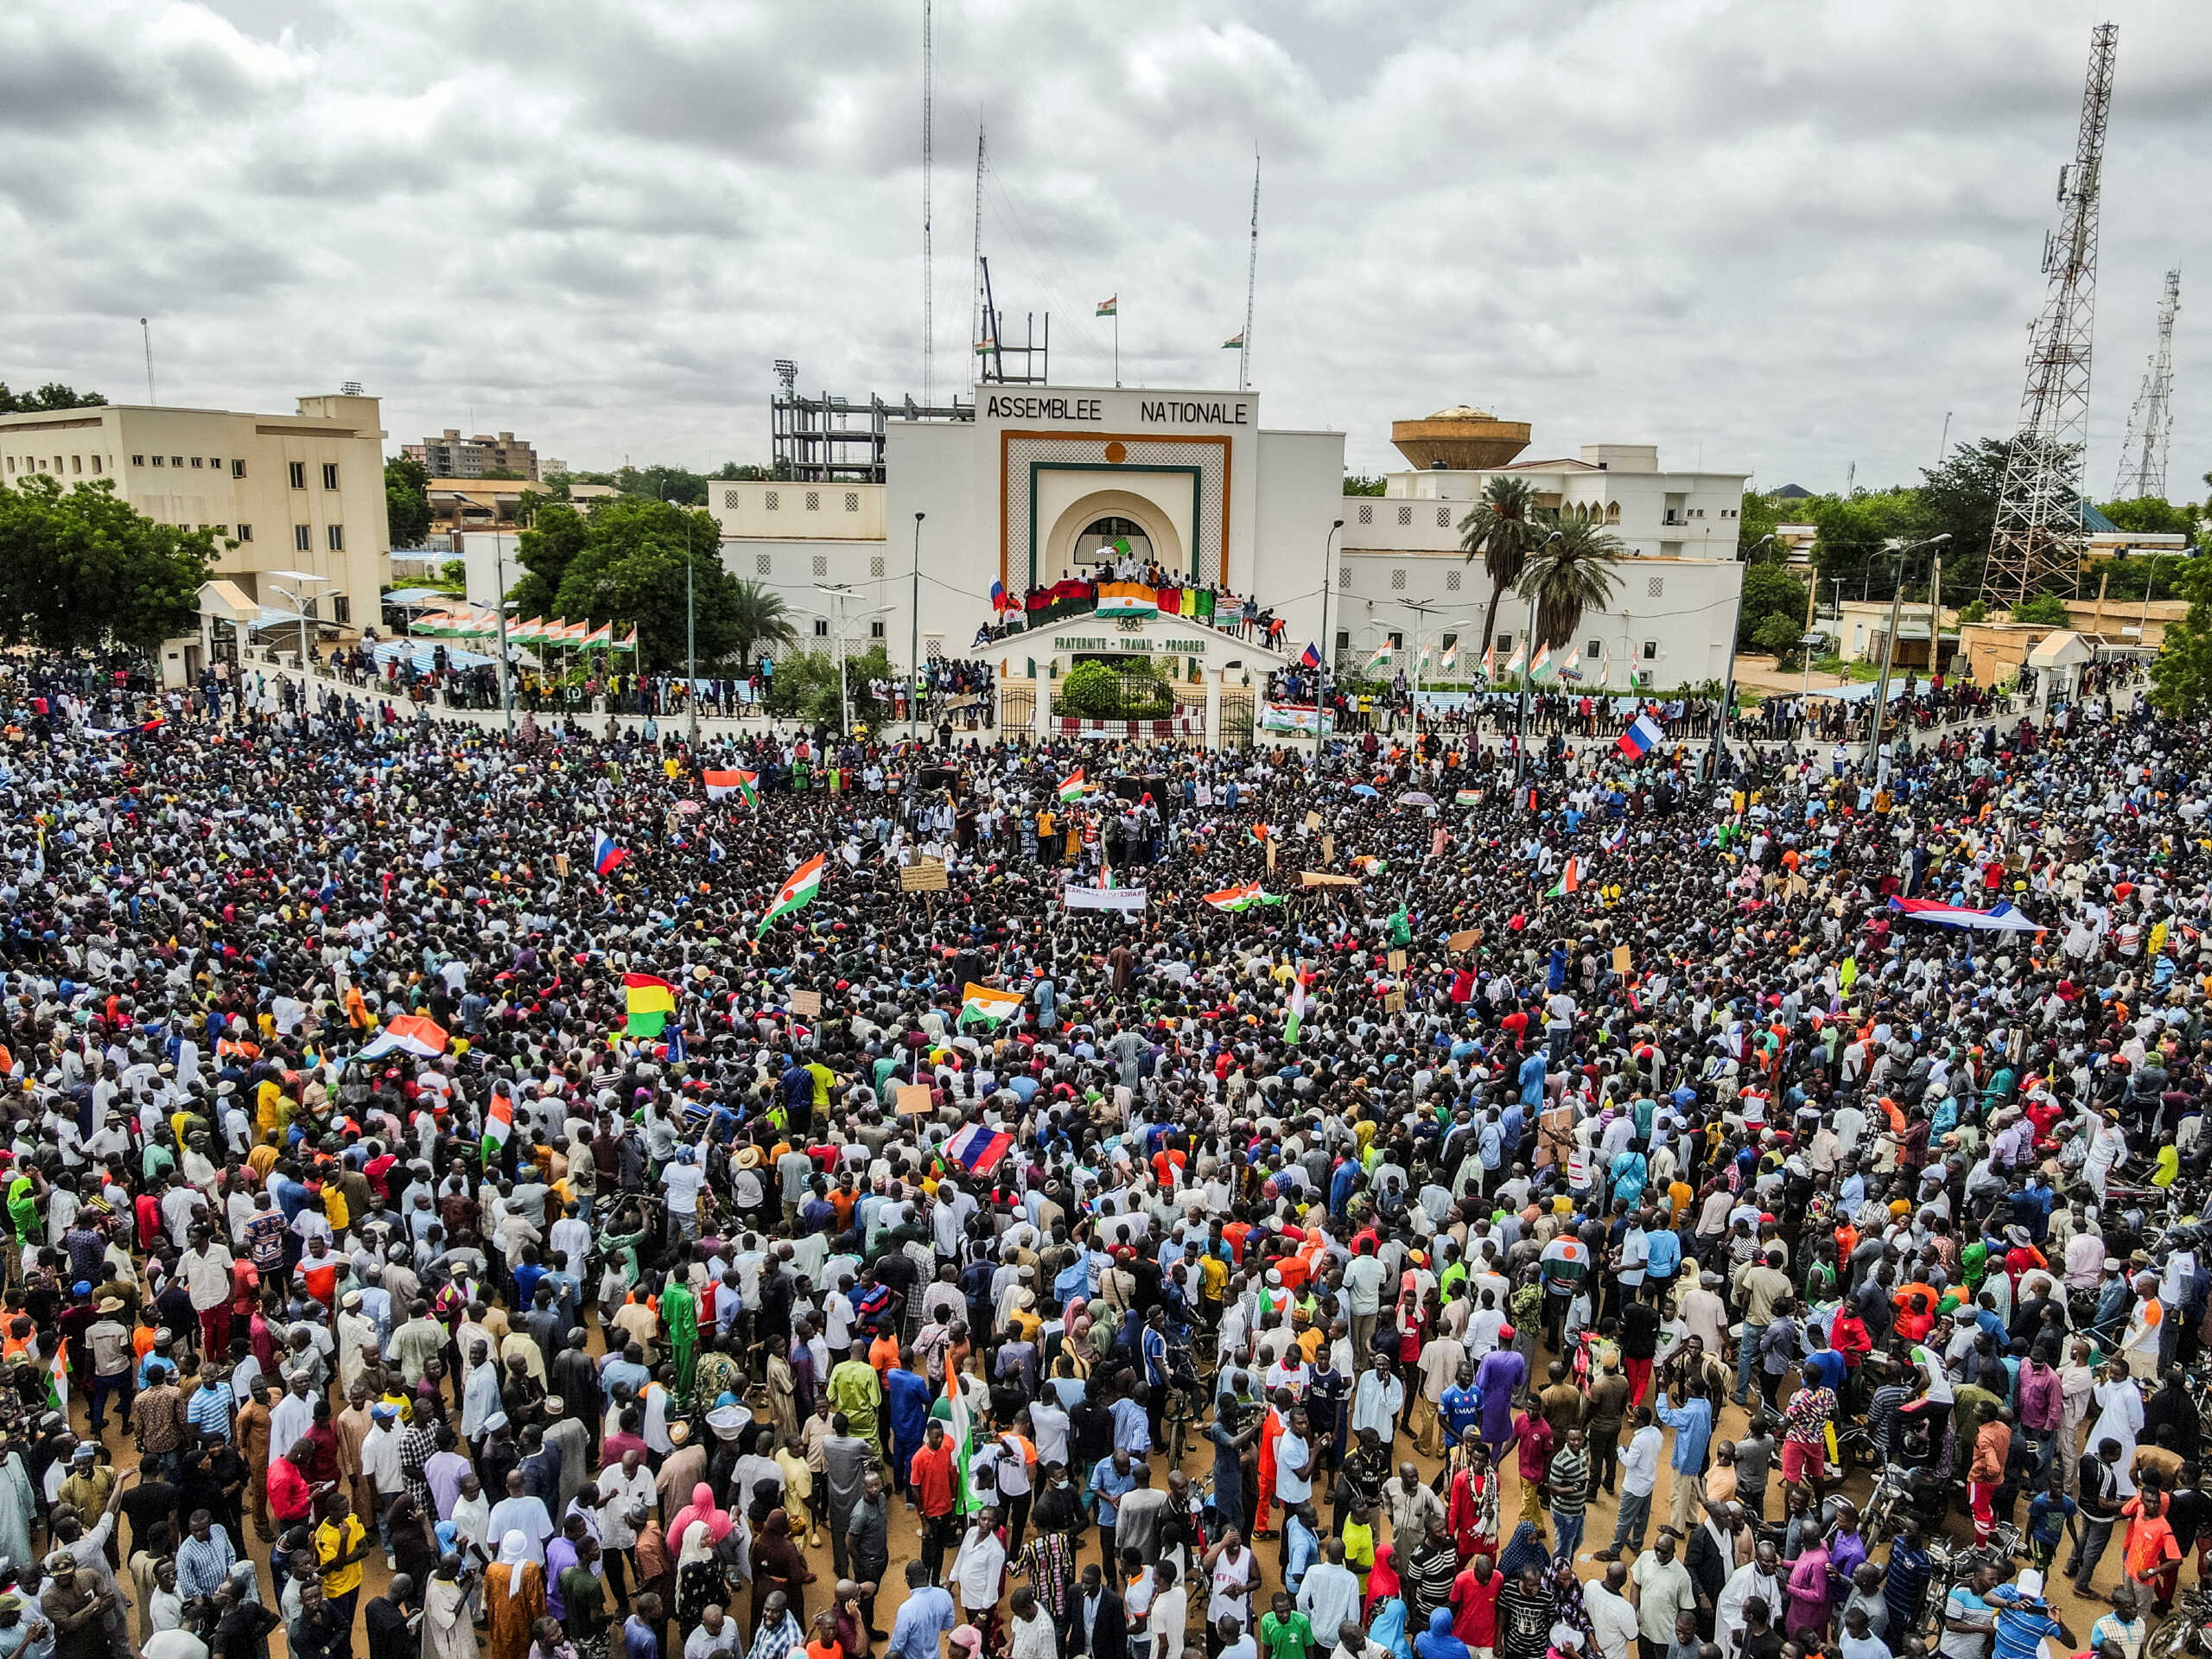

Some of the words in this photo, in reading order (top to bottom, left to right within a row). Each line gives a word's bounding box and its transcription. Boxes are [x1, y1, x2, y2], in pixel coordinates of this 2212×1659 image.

[987, 396, 1102, 420] ASSEMBLEE
[1141, 401, 1247, 424] NATIONALE
[1054, 637, 1107, 650] FRATERNITE
[1120, 638, 1154, 652] TRAVAIL
[1166, 639, 1205, 652] PROGRES
